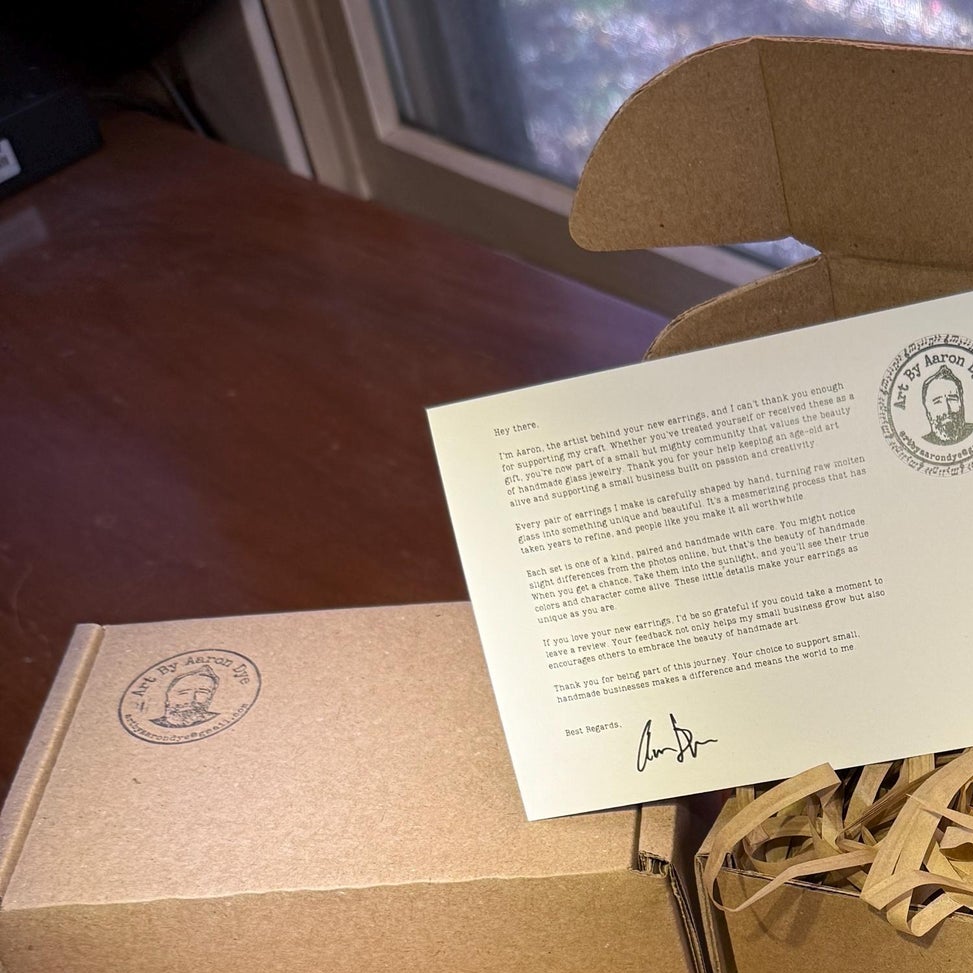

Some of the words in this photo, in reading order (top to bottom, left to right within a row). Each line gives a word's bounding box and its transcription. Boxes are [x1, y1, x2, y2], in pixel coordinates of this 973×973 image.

[893, 383, 909, 410] Art
[904, 363, 922, 381] By
[924, 353, 966, 367] Aaron
[517, 453, 566, 469] supporting
[609, 436, 647, 449] Whether
[650, 430, 679, 443] you've
[681, 422, 713, 435] treated
[715, 413, 753, 430] yourself
[768, 402, 806, 417] received
[808, 398, 834, 408] these
[563, 435, 588, 447] artist
[590, 428, 621, 441] behind
[737, 400, 759, 411] can't
[761, 394, 789, 406] thank
[810, 382, 844, 396] enough
[518, 479, 563, 494] handmade
[565, 474, 588, 486] glass
[626, 459, 656, 472] Thank
[738, 435, 774, 449] keeping
[525, 468, 553, 481] you're
[615, 450, 640, 462] small
[659, 440, 691, 453] mighty
[694, 429, 745, 445] community
[770, 418, 800, 429] values
[819, 407, 851, 419] beauty
[510, 498, 531, 507] alive
[551, 483, 600, 499] supporting
[609, 476, 634, 488] small
[635, 469, 675, 482] business
[677, 463, 700, 474] built
[715, 454, 749, 468] passion
[515, 520, 541, 531] Every
[574, 506, 612, 520] earrings
[657, 489, 697, 503] carefully
[699, 482, 731, 495] shaped
[775, 466, 812, 479] turning
[518, 533, 541, 545] glass
[562, 519, 608, 535] something
[609, 513, 640, 525] unique
[731, 483, 790, 501] mesmerizing
[792, 477, 826, 490] process
[520, 544, 546, 554] taken
[547, 539, 572, 551] years
[635, 521, 662, 534] people
[636, 545, 664, 558] paired
[684, 533, 730, 548] handmade
[799, 513, 827, 525] might
[829, 508, 856, 520] notice
[529, 578, 555, 590] slight
[556, 569, 605, 584] differences
[648, 556, 677, 569] photos
[728, 540, 755, 551] that's
[774, 531, 804, 543] beauty
[780, 542, 806, 556] you'll
[824, 535, 847, 545] their
[534, 602, 561, 612] colors
[580, 590, 622, 604] character
[674, 576, 700, 586] These
[702, 571, 723, 581] little
[725, 565, 755, 576] details
[807, 548, 846, 561] earrings
[714, 602, 750, 617] grateful
[780, 592, 804, 603] could
[835, 579, 872, 593] moment
[537, 613, 568, 624] unique
[545, 649, 568, 658] leave
[635, 629, 673, 642] feedback
[713, 618, 737, 628] helps
[756, 609, 781, 620] small
[782, 601, 823, 615] business
[548, 655, 596, 670] encourages
[597, 650, 626, 661] others
[638, 641, 675, 654] embrace
[693, 632, 723, 643] beauty
[736, 621, 782, 636] handmade
[131, 676, 157, 697] Art
[156, 662, 178, 675] By
[185, 656, 233, 667] Aaron
[233, 663, 250, 685] Dye
[553, 681, 581, 692] Thank
[616, 670, 641, 681] being
[755, 645, 783, 656] choice
[796, 636, 831, 649] support
[556, 690, 601, 704] handmade
[602, 681, 650, 695] businesses
[651, 676, 680, 687] makes
[689, 666, 733, 680] difference
[754, 657, 783, 668] means
[802, 648, 827, 659] world
